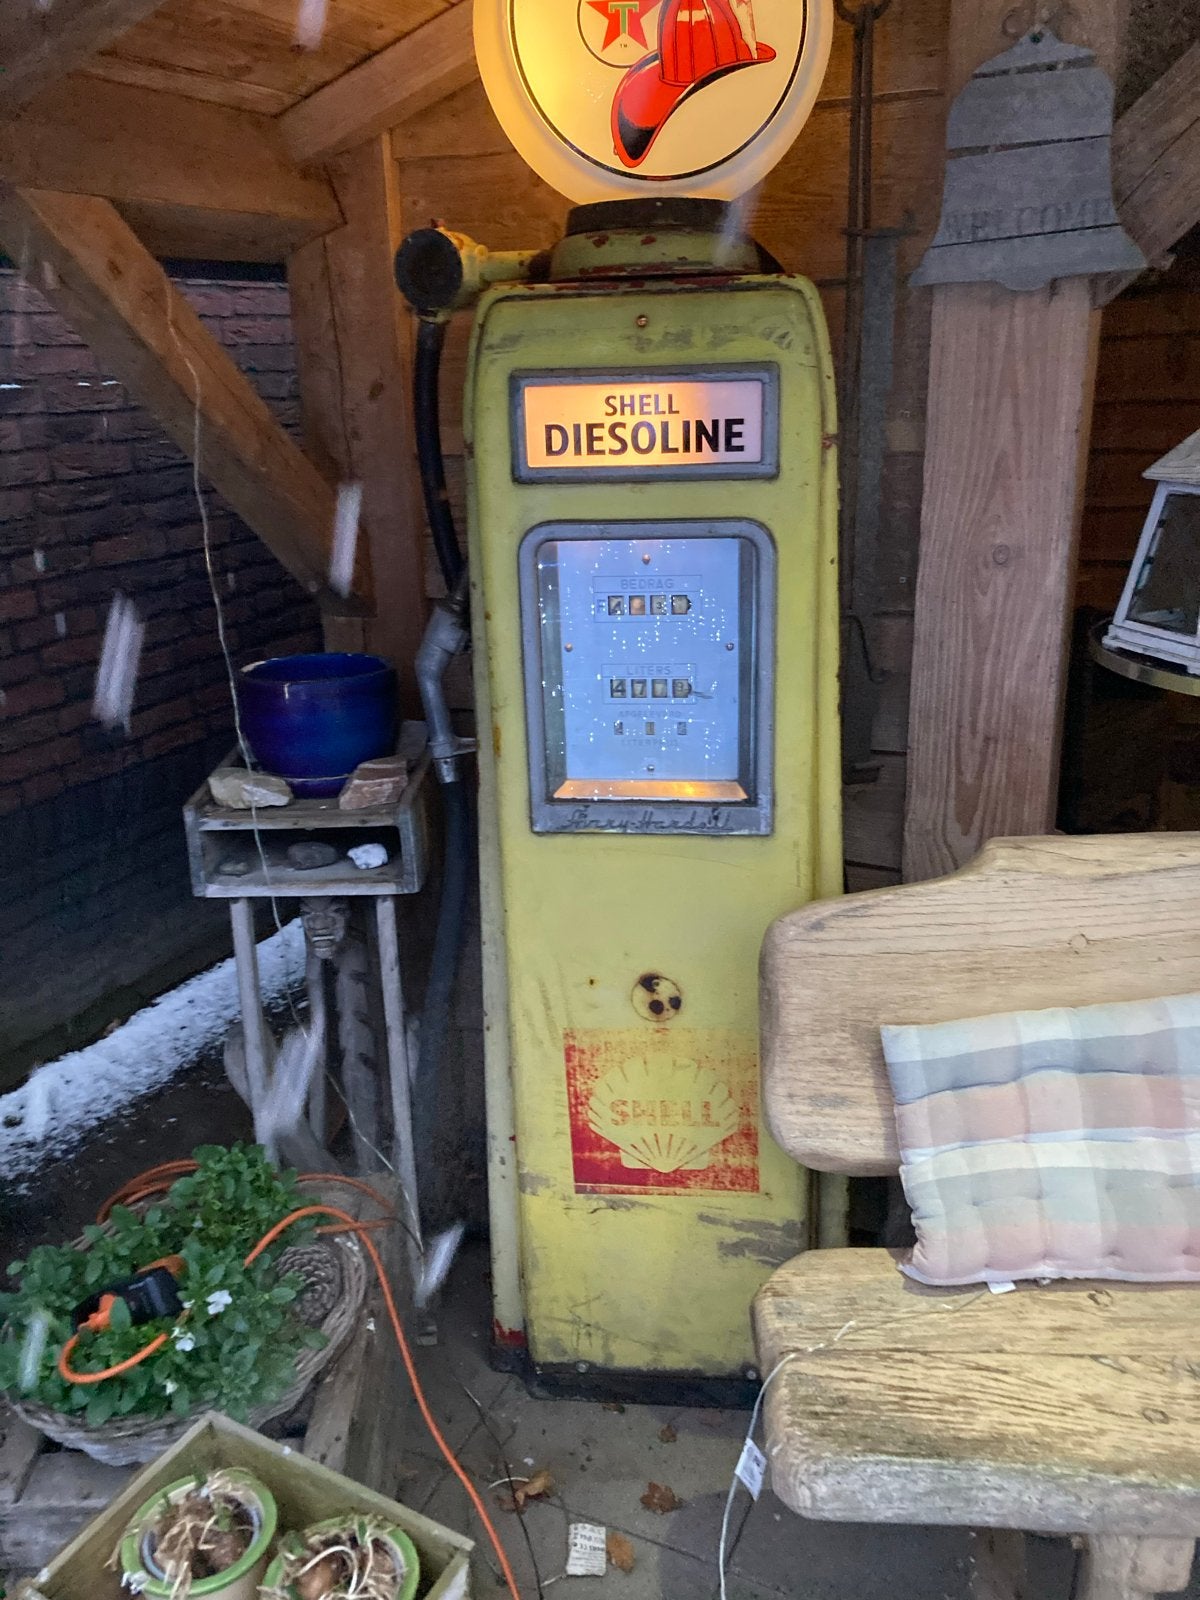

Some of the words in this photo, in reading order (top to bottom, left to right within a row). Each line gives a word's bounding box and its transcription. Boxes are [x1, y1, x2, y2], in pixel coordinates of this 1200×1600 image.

[608, 1, 640, 35] T
[604, 393, 680, 417] SHELL
[544, 418, 745, 457] DIESOLINE
[620, 578, 675, 590] BEDRAG
[626, 665, 672, 676] LITERS
[609, 1099, 721, 1127] SHELL
